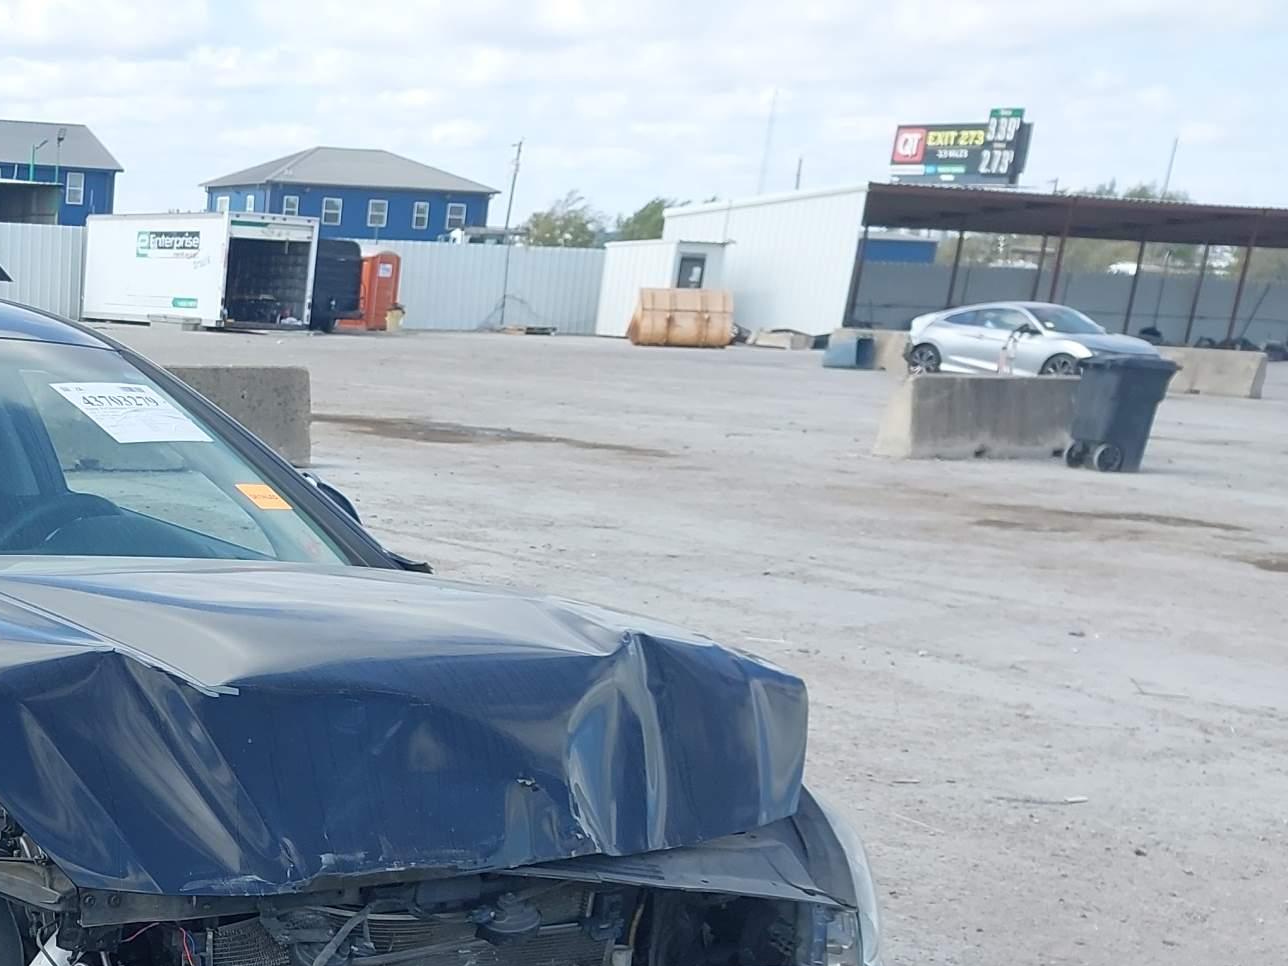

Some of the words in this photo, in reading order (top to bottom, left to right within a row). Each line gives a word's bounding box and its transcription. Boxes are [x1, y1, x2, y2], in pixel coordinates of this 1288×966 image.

[926, 130, 958, 146] EXIT
[958, 129, 985, 145] 273
[150, 232, 200, 250] Enterprise
[81, 395, 159, 407] 43703279
